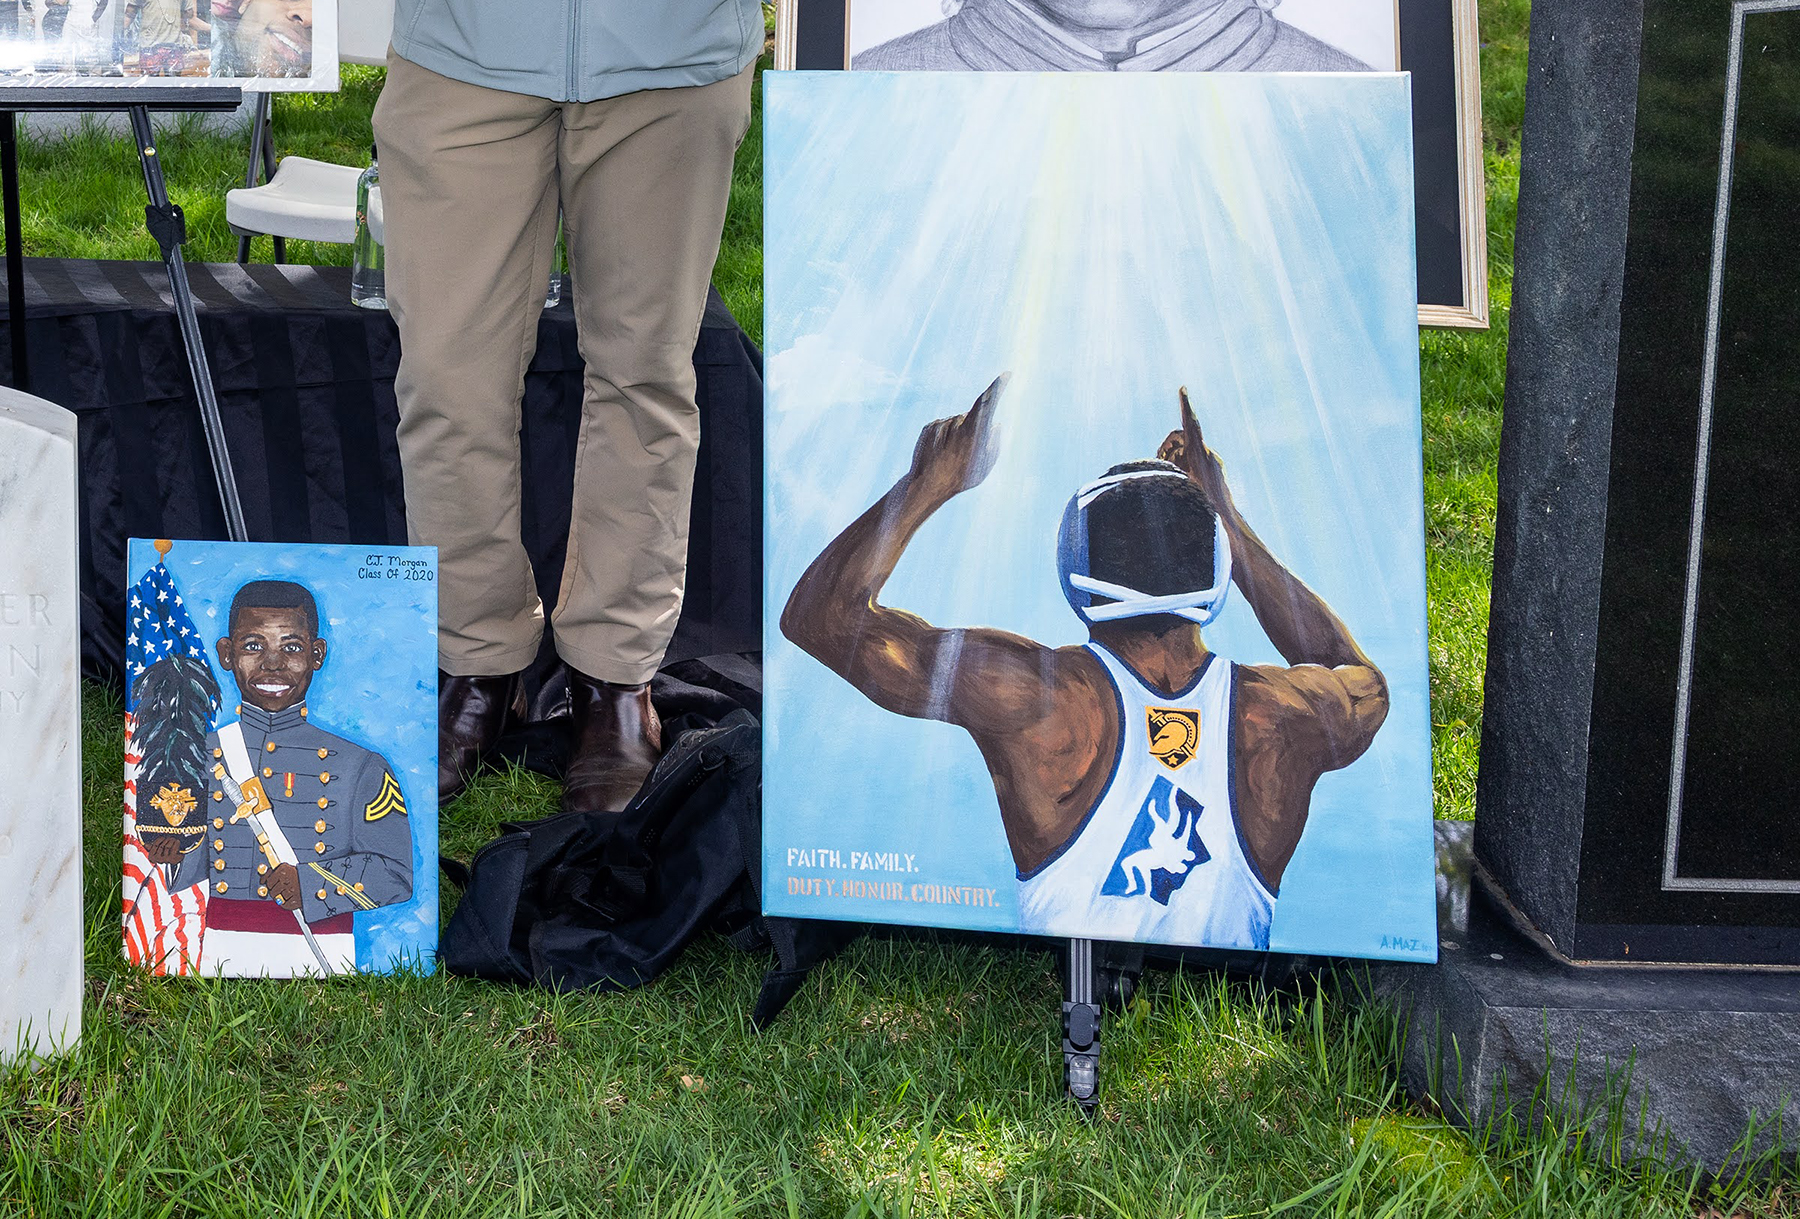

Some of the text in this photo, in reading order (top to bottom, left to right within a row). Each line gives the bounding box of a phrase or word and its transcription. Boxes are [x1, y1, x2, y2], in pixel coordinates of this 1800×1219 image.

[388, 555, 428, 570] Morgan
[357, 567, 382, 580] Class
[403, 569, 434, 582] 2020
[787, 847, 920, 874] FAITH. FAMILY.
